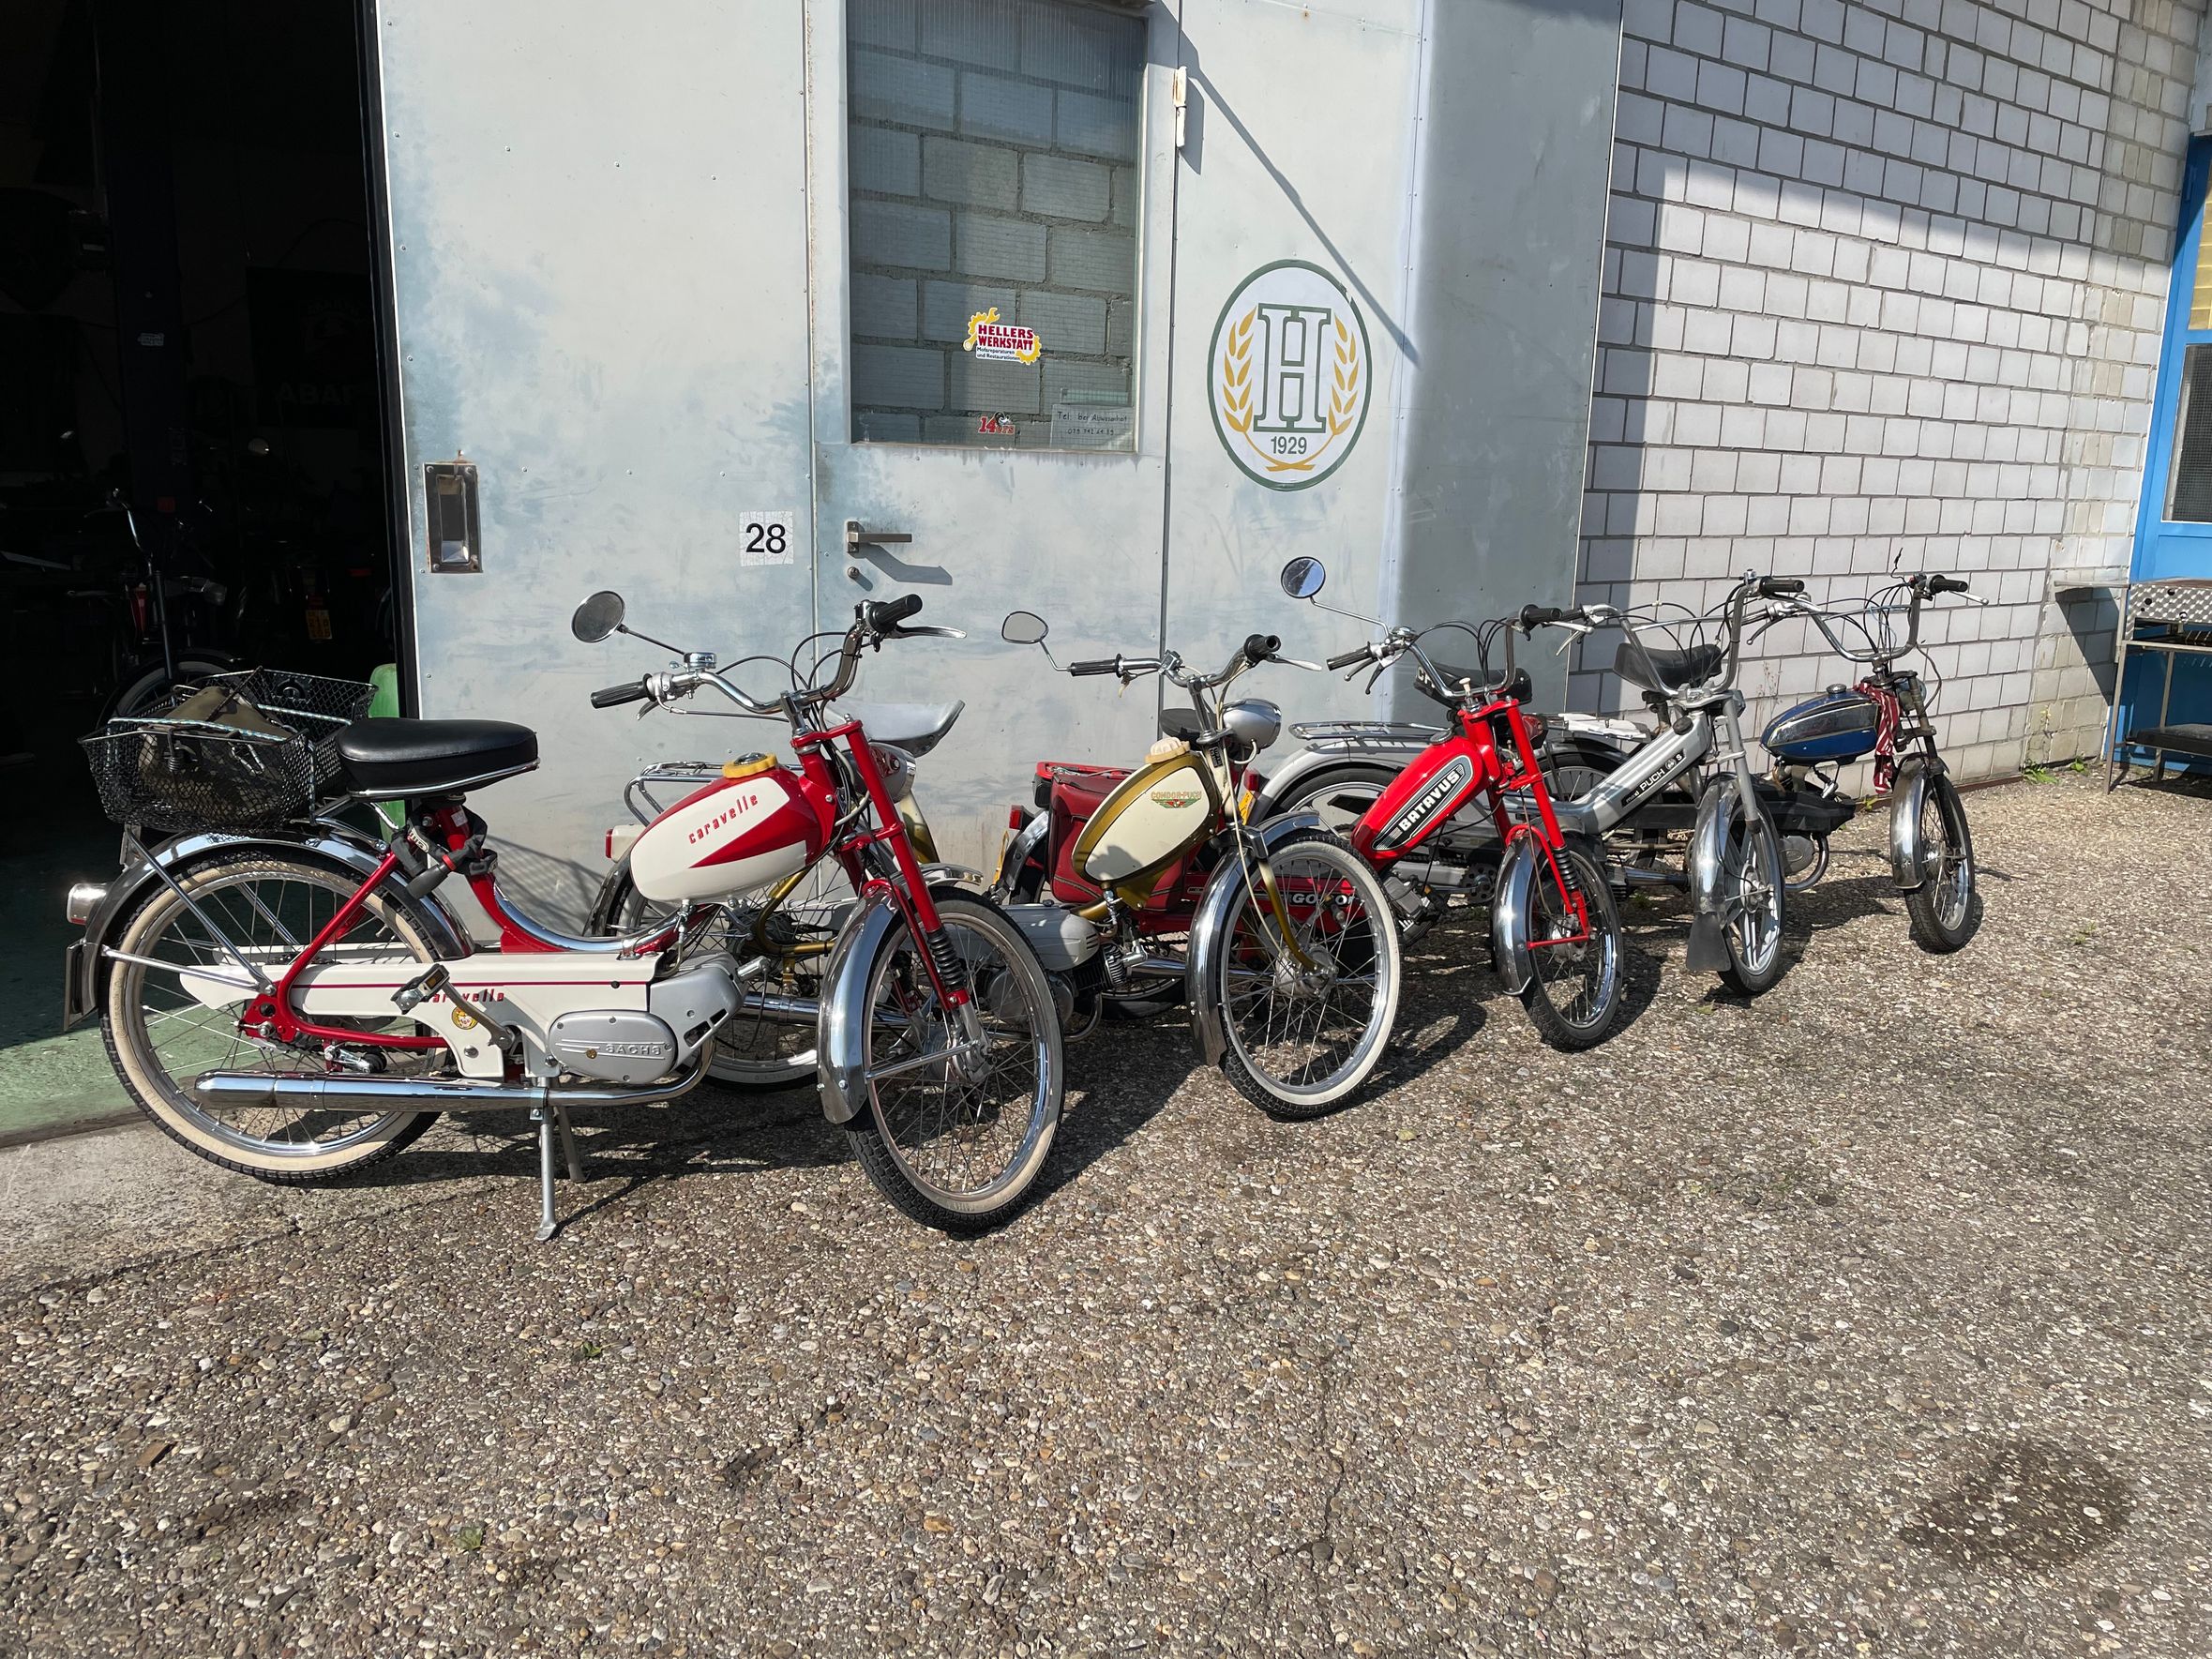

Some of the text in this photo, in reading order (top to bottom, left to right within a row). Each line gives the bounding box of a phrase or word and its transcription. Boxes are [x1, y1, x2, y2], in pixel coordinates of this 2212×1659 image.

[978, 324, 1033, 339] HELLERS
[978, 335, 1033, 351] WERKSTATT
[1271, 436, 1307, 455] 1929
[745, 522, 787, 554] 28
[1639, 768, 1665, 791] PUCH
[1398, 770, 1460, 832] BATAVUS
[688, 794, 759, 845] caravelle
[606, 1043, 662, 1056] SACHS
